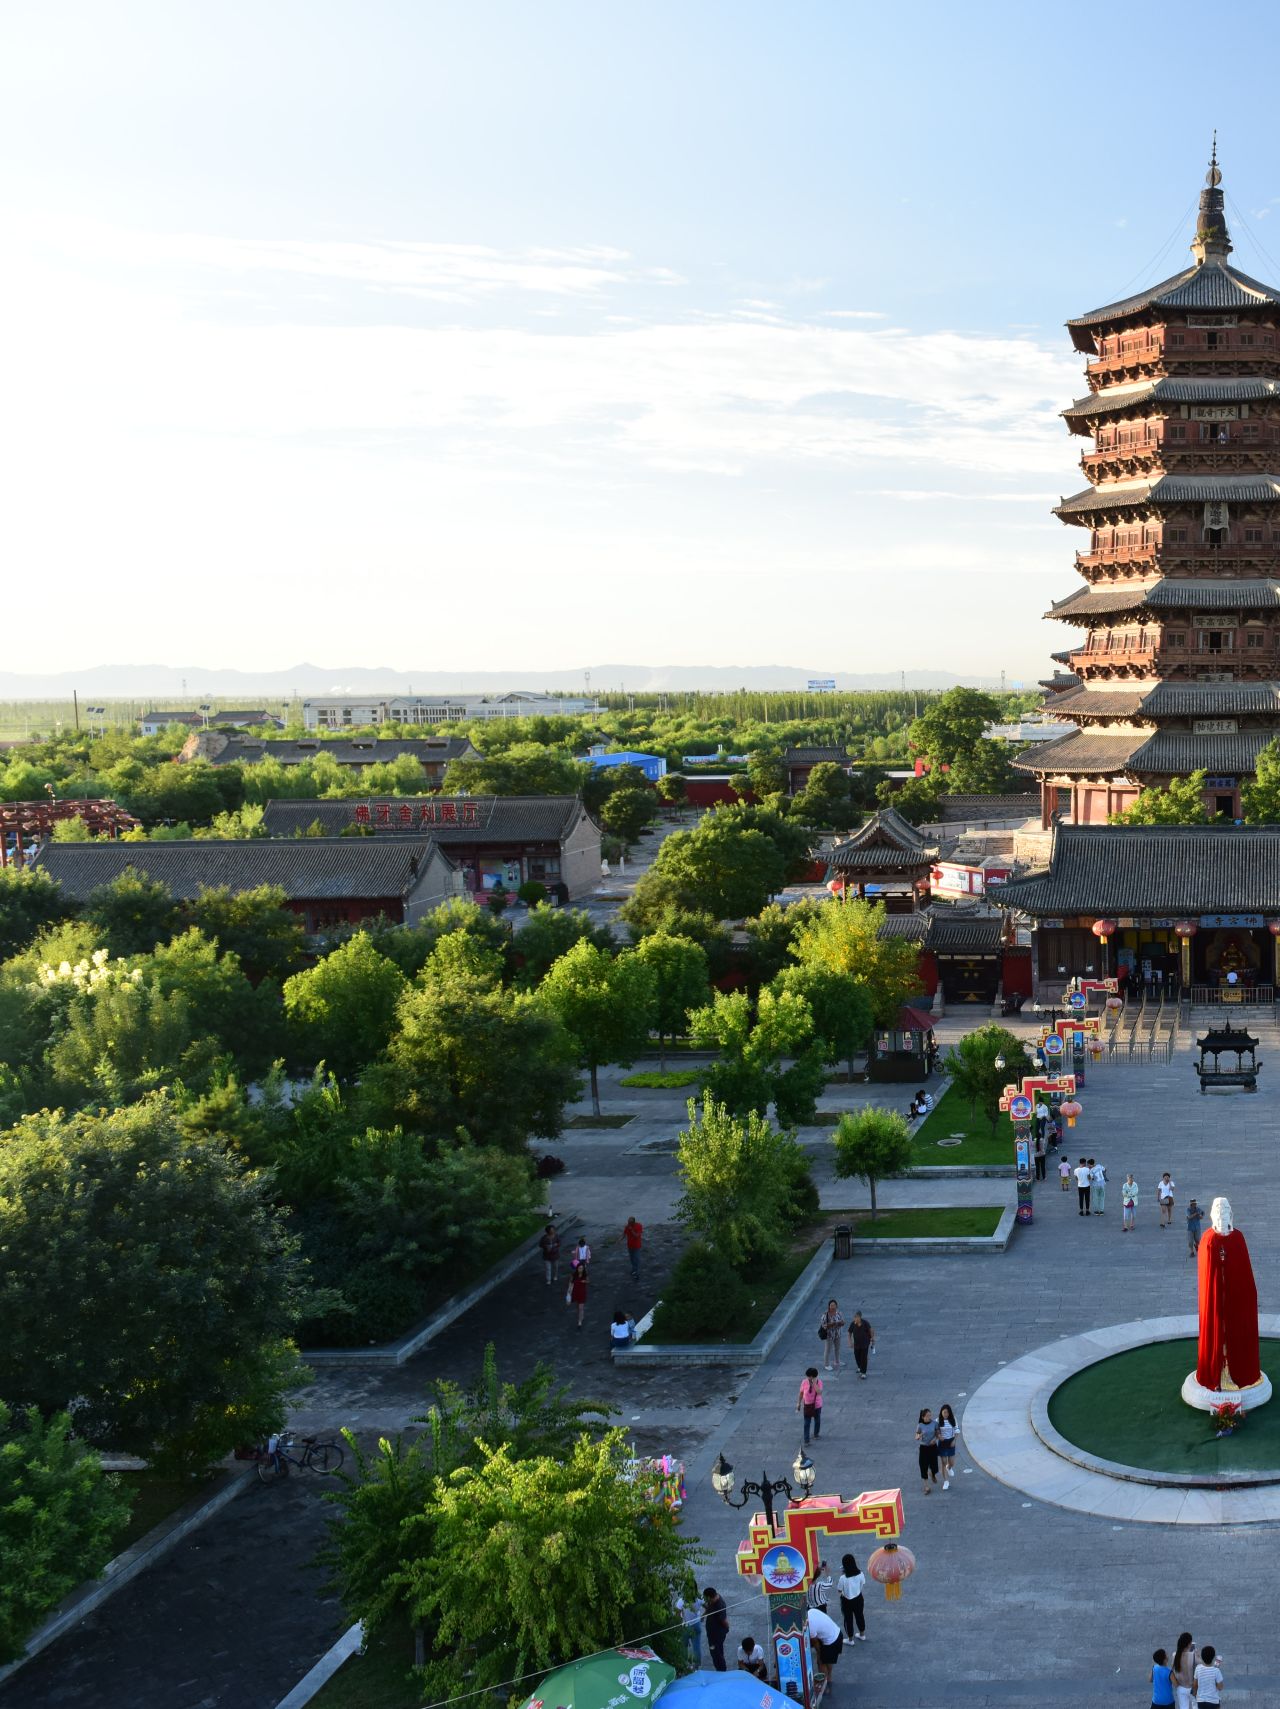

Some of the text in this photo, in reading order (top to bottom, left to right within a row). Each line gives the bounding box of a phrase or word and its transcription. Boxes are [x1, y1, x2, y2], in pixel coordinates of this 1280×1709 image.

[355, 802, 480, 822] 佛牙舍利展厅
